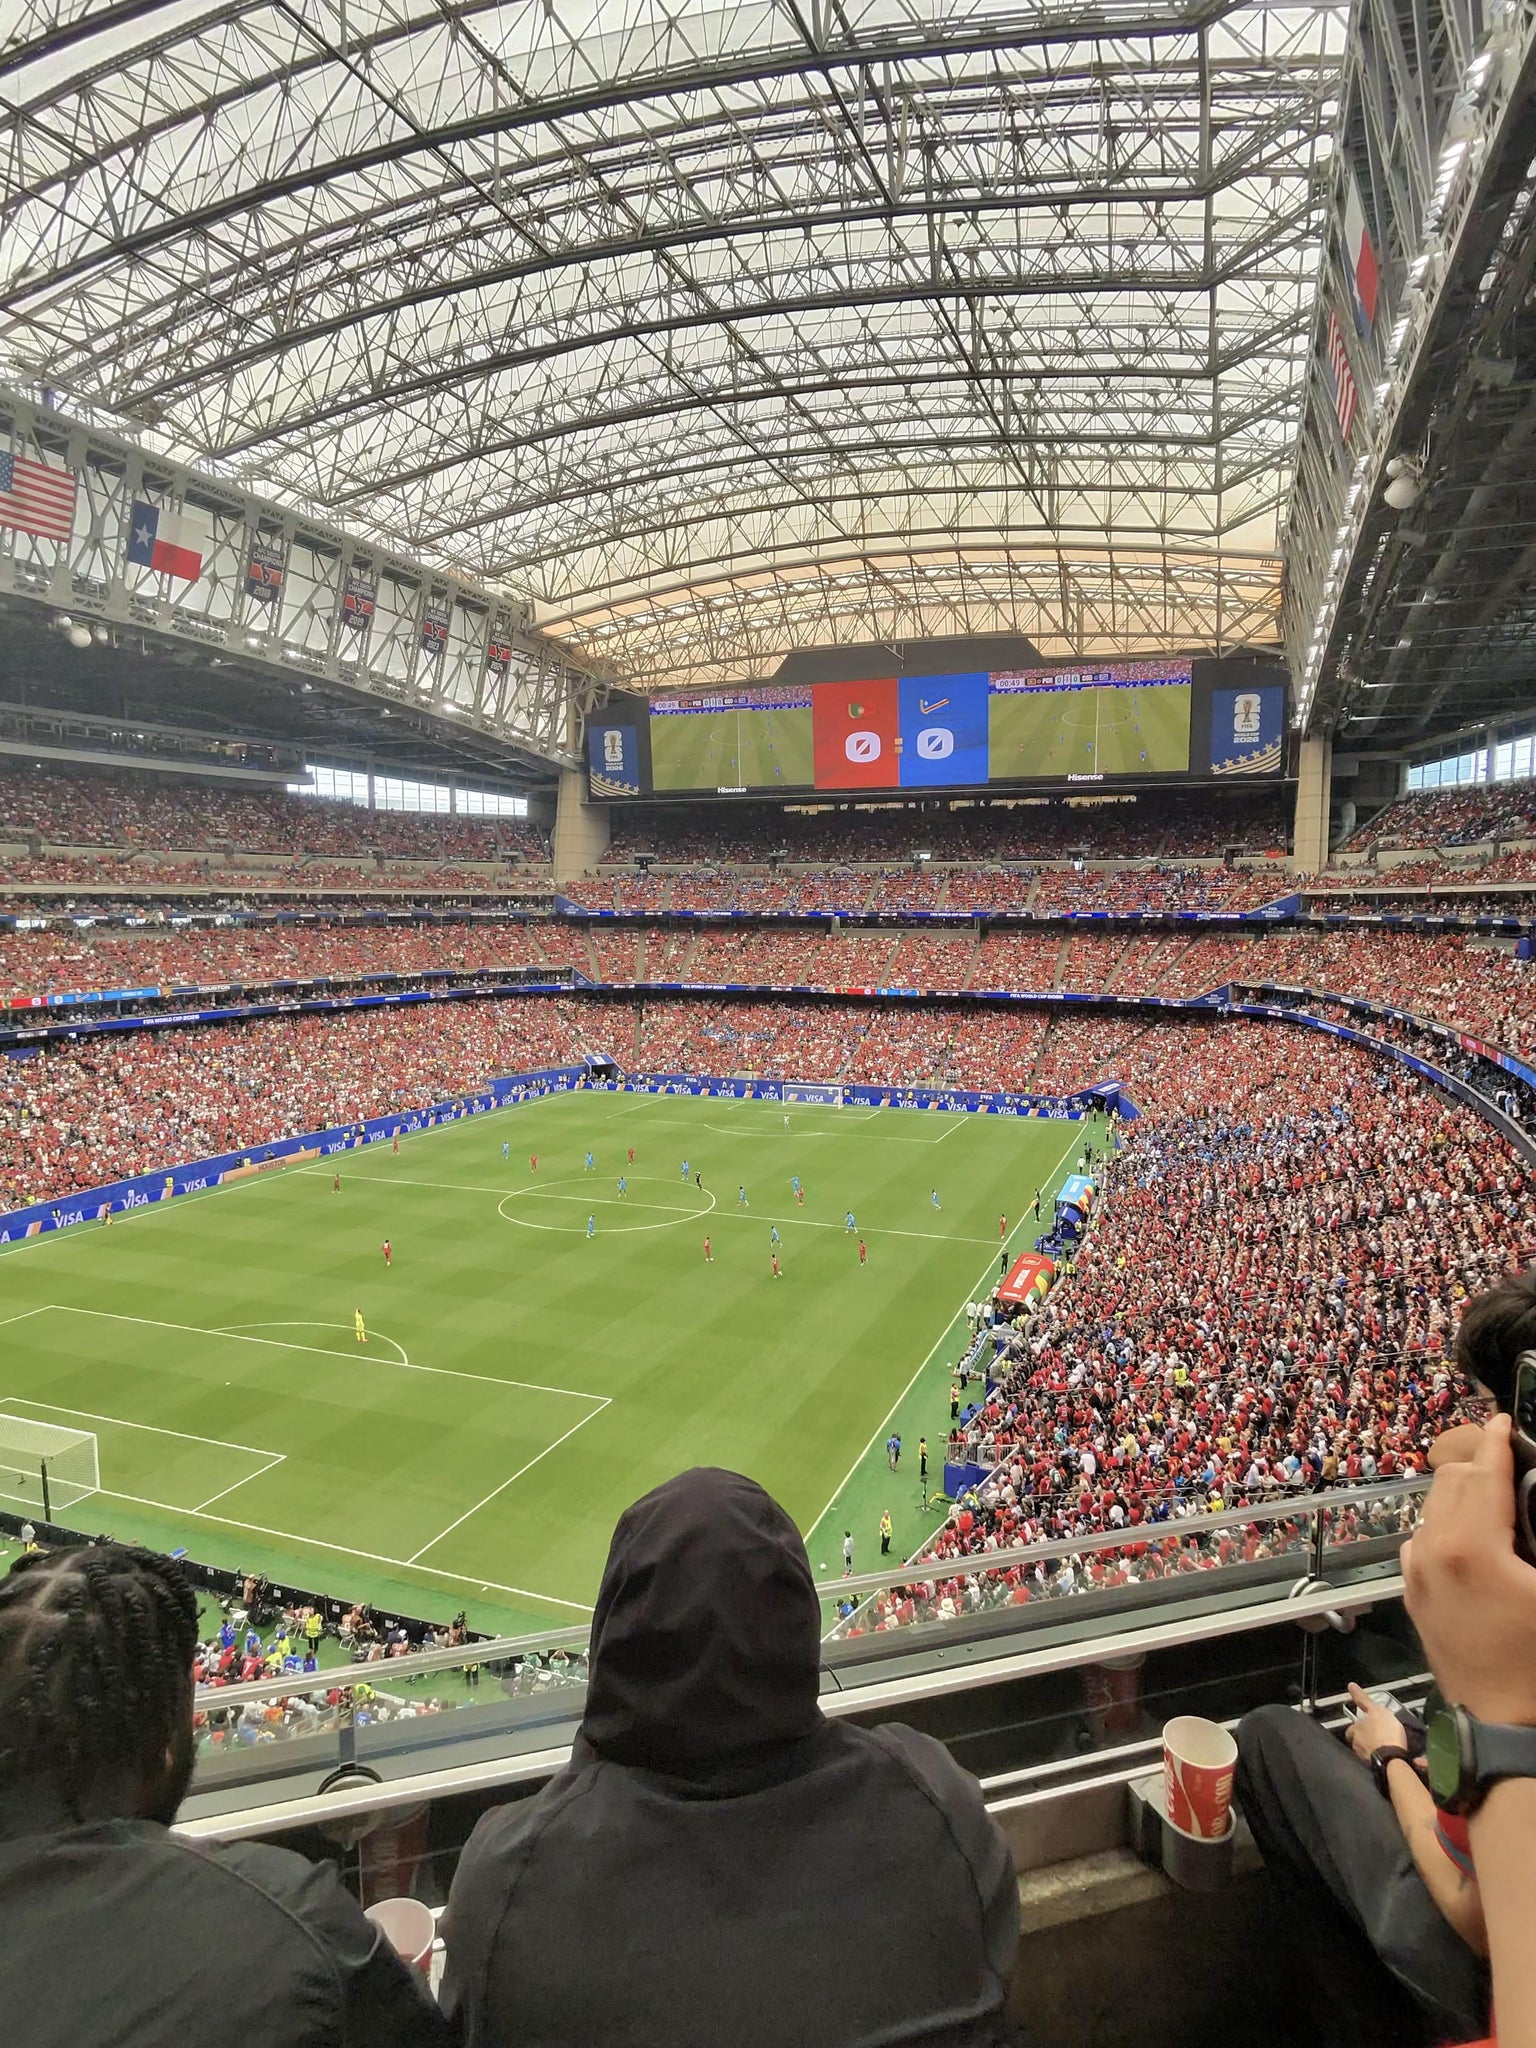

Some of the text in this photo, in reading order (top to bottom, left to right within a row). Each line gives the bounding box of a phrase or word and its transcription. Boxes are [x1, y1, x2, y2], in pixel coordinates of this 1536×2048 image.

[999, 679, 1021, 688] 00:49
[1067, 773, 1104, 782] Hisense
[717, 786, 747, 794] Hisense
[198, 985, 231, 993] HOUSTON
[553, 1082, 567, 1092] VISA
[591, 1081, 608, 1091] VISA
[632, 1083, 649, 1093] VISA
[673, 1085, 692, 1095] VISA
[717, 1088, 735, 1098] VISA
[761, 1091, 780, 1101] VISA
[804, 1093, 824, 1103] VISA
[501, 1096, 514, 1106] VISA
[851, 1096, 870, 1106] VISA
[898, 1099, 918, 1109] VISA
[472, 1103, 486, 1114] VISA
[947, 1102, 968, 1112] VISA
[998, 1106, 1018, 1115] VISA
[440, 1112, 455, 1123] VISA
[1048, 1109, 1069, 1120] VISA
[407, 1121, 422, 1132] VISA
[369, 1130, 386, 1142] VISA
[328, 1141, 347, 1153] VISA
[258, 1158, 286, 1172] HOUSTON
[184, 1178, 207, 1193] VISA
[122, 1192, 149, 1210] VISA
[54, 1210, 84, 1228] VISA
